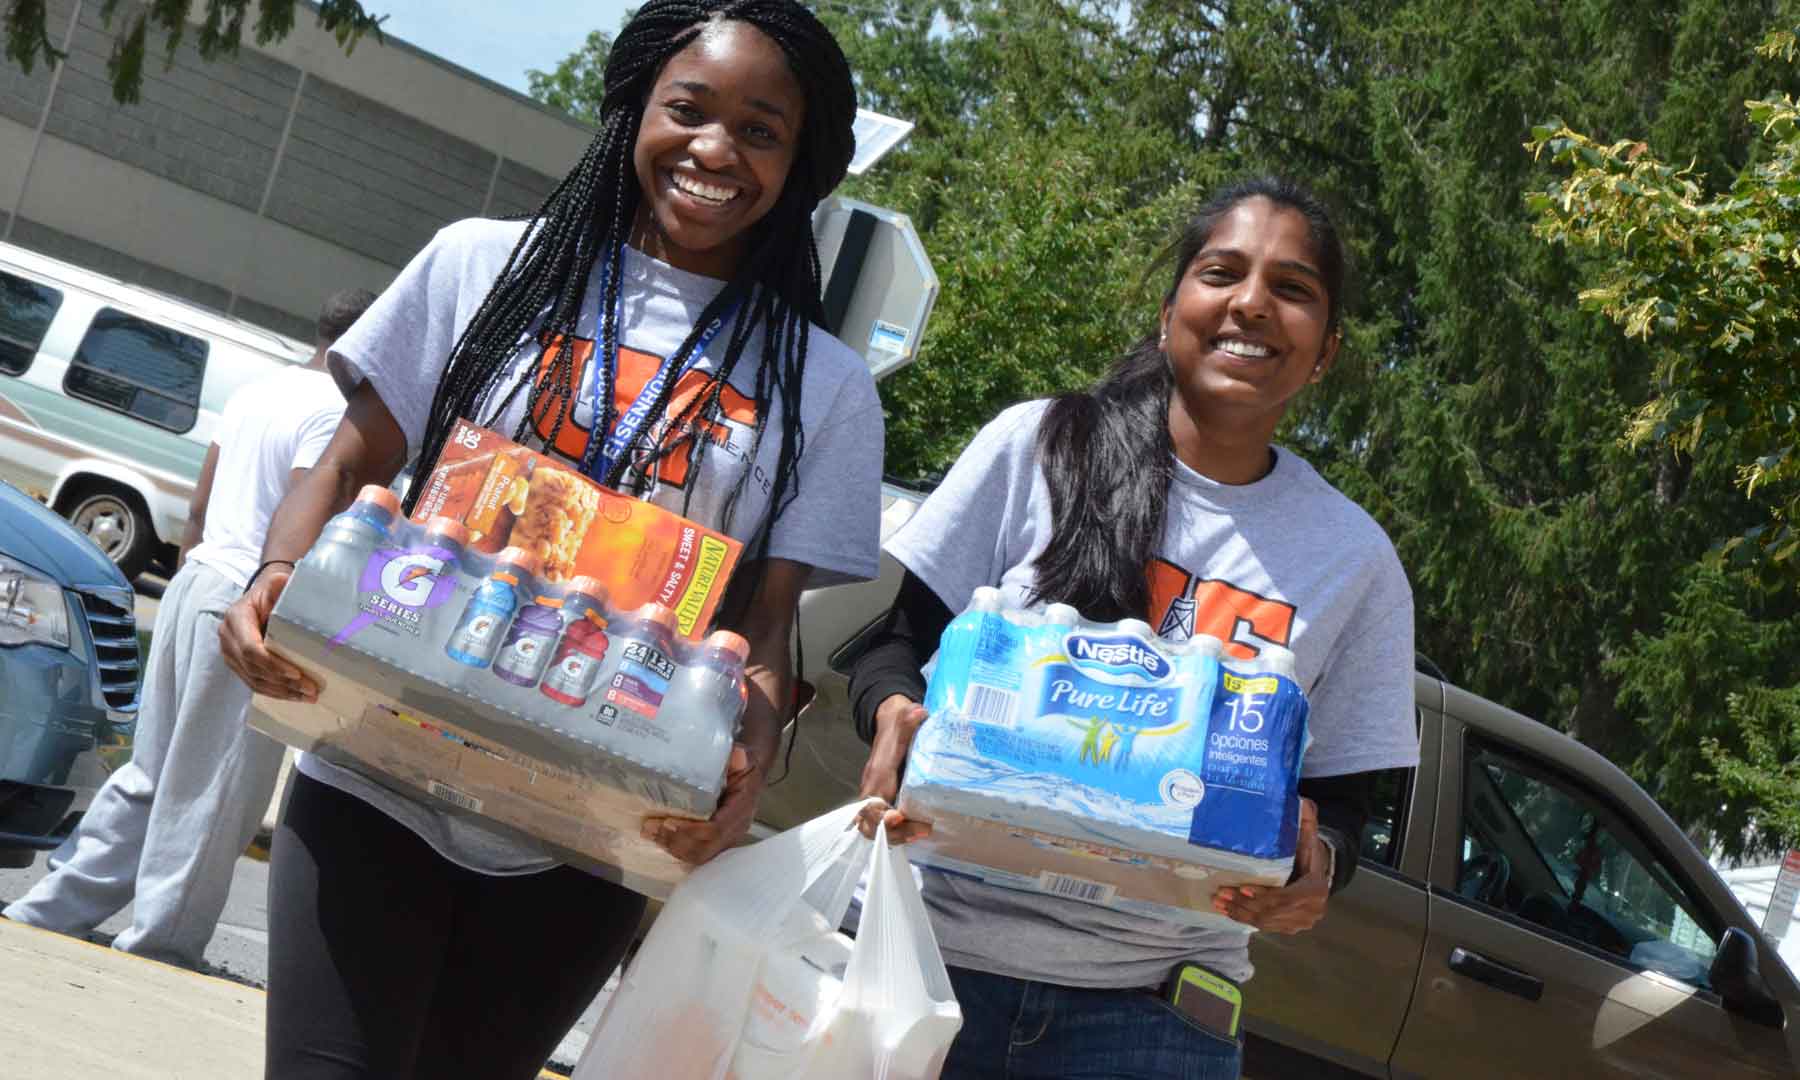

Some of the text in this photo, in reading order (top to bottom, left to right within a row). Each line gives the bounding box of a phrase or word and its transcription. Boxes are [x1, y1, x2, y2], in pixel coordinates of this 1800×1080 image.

[603, 346, 698, 460] EISENHO
[464, 430, 481, 449] 30
[488, 475, 510, 511] Peanut
[679, 527, 695, 561] SWEET
[381, 554, 445, 606] G
[673, 561, 685, 570] &
[660, 571, 682, 602] SALTY
[678, 540, 725, 632] NATURE VALLEY
[370, 594, 420, 623] SERIES
[627, 643, 648, 658] 24
[1077, 638, 1160, 671] Nestlé
[608, 689, 617, 701] 8
[613, 674, 623, 688] 8
[1051, 679, 1169, 716] Pure Life
[1224, 697, 1265, 733] 15
